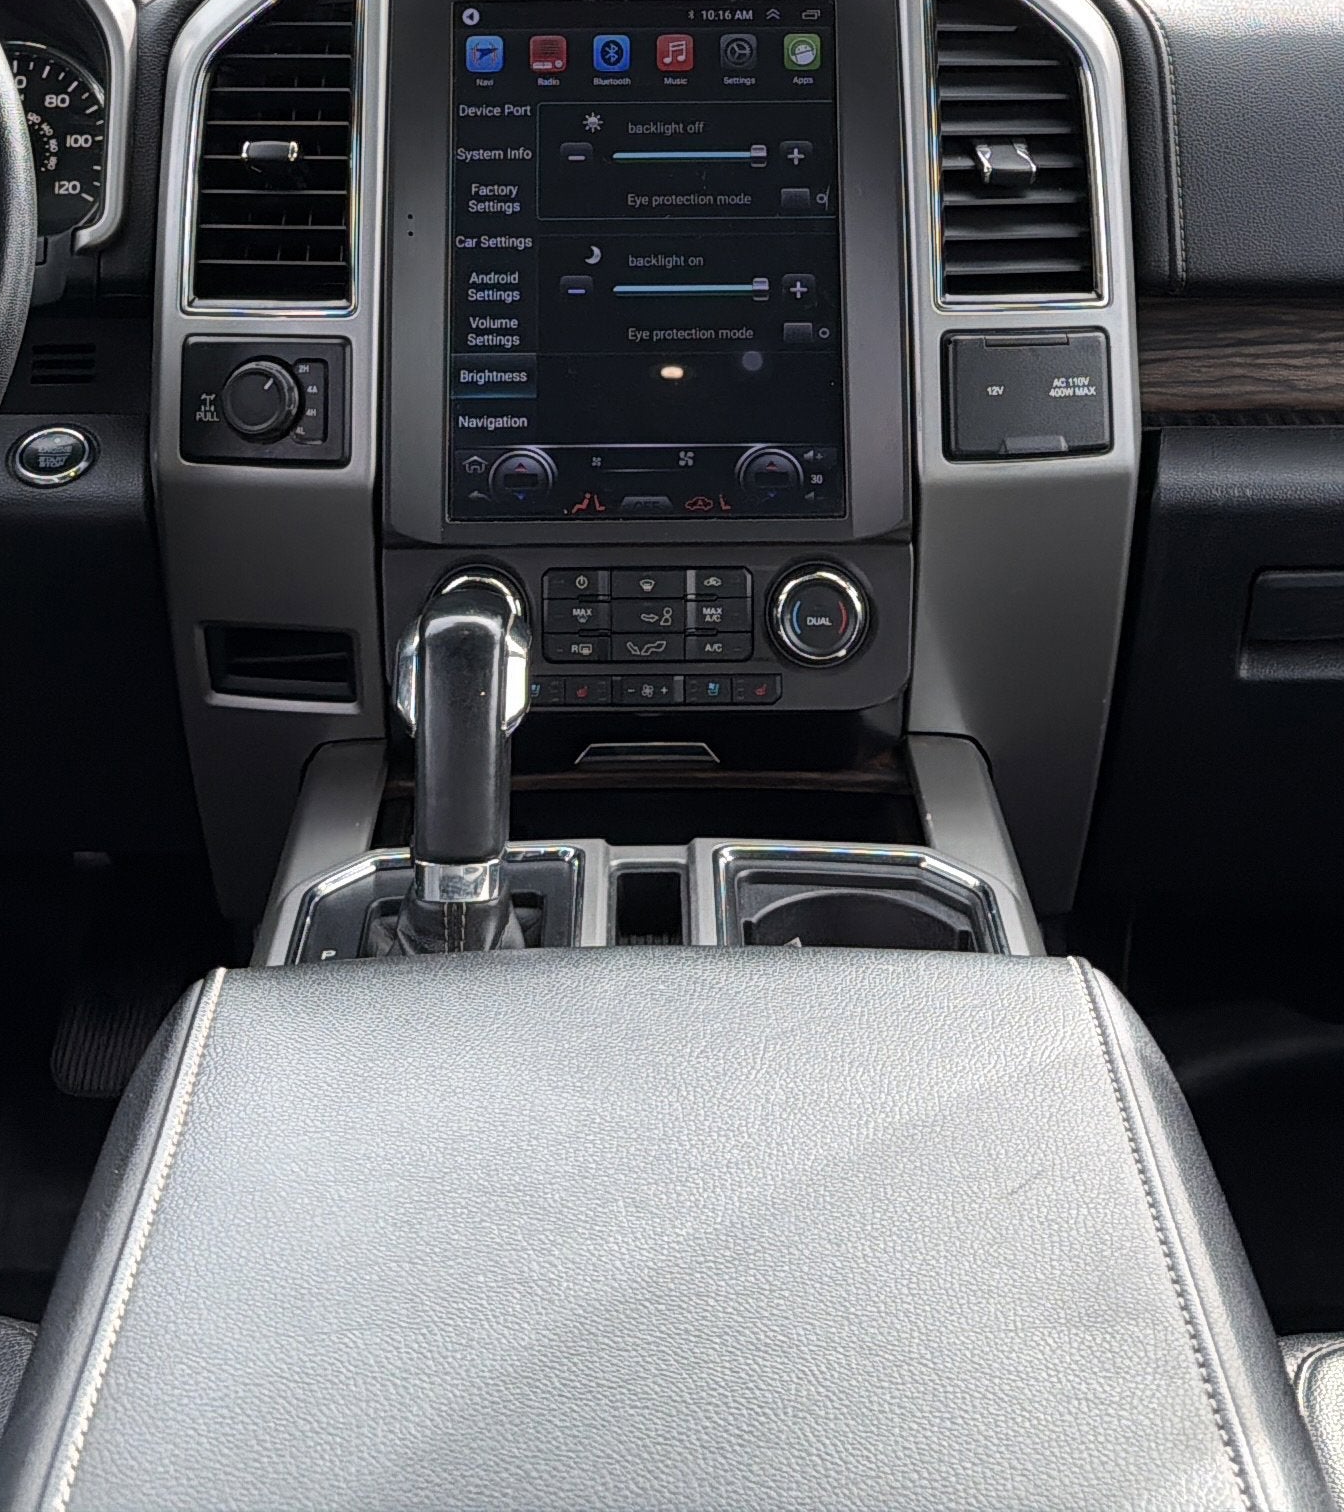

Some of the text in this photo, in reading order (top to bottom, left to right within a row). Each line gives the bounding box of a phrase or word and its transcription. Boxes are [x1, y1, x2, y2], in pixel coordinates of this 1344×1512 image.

[734, 9, 753, 20] AM
[537, 78, 559, 86] Radio
[593, 77, 631, 85] Bluetooth
[664, 76, 687, 85] Music
[723, 76, 755, 85] Settings
[793, 76, 813, 85] Apps
[44, 94, 69, 107] 80
[459, 104, 531, 117] Device Port
[628, 122, 704, 135] backlight off
[66, 134, 92, 148] 100
[457, 148, 532, 161] System Info
[54, 181, 81, 195] 120
[471, 184, 518, 197] Factory
[627, 193, 752, 207] Eye protection mode
[468, 199, 520, 214] Settings
[456, 235, 532, 249] Car Settings
[628, 254, 704, 268] backlight on
[469, 271, 518, 284] Android
[467, 288, 520, 303] Settings
[469, 317, 518, 328] Volume
[628, 326, 754, 342] Eye protection mode
[467, 333, 520, 347] Settings
[298, 364, 309, 373] 2H
[460, 370, 527, 384] Brightness
[1052, 376, 1090, 387] AC 110V
[987, 385, 1004, 396] 12V
[1048, 386, 1096, 398] 400W MAX
[196, 411, 220, 422] PULL
[306, 409, 317, 417] 4H
[458, 415, 528, 429] Navigation
[296, 426, 306, 435] 4L
[810, 474, 823, 484] 30
[572, 608, 592, 617] MAX
[703, 607, 723, 616] MAX
[705, 614, 721, 623] A/C
[807, 616, 832, 626] DUAL
[571, 644, 578, 653] R
[705, 643, 722, 653] A/C
